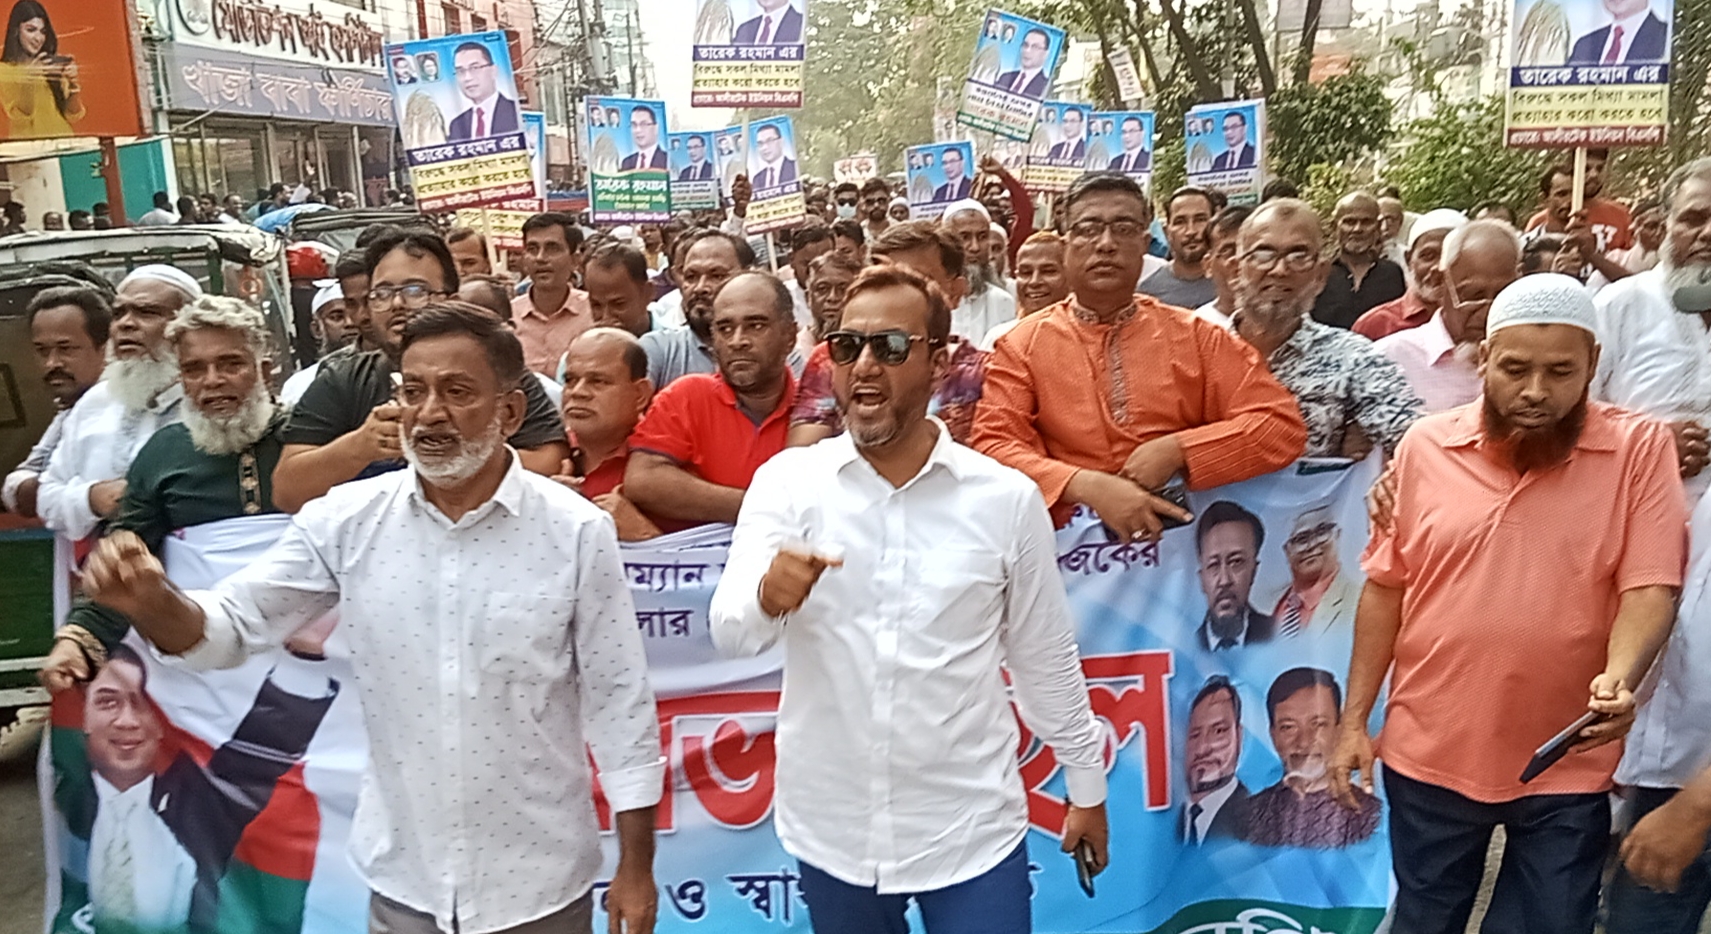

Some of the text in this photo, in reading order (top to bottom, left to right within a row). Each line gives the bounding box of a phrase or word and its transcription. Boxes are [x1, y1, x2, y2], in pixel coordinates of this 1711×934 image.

[698, 46, 799, 60] তারেক রহমান এর
[182, 60, 253, 108] খাজা
[255, 71, 312, 114] বাবা
[1519, 65, 1661, 86] তারেক রহমান এর
[1558, 91, 1588, 104] সকল
[1591, 87, 1622, 104] মিথ্যা
[1627, 89, 1664, 104] মামলা
[1600, 108, 1635, 121] করতে
[1640, 107, 1662, 120] হবে
[412, 136, 520, 162] তারেক রহমান এর
[1057, 540, 1160, 575] জকের
[624, 559, 710, 592] ম্যান
